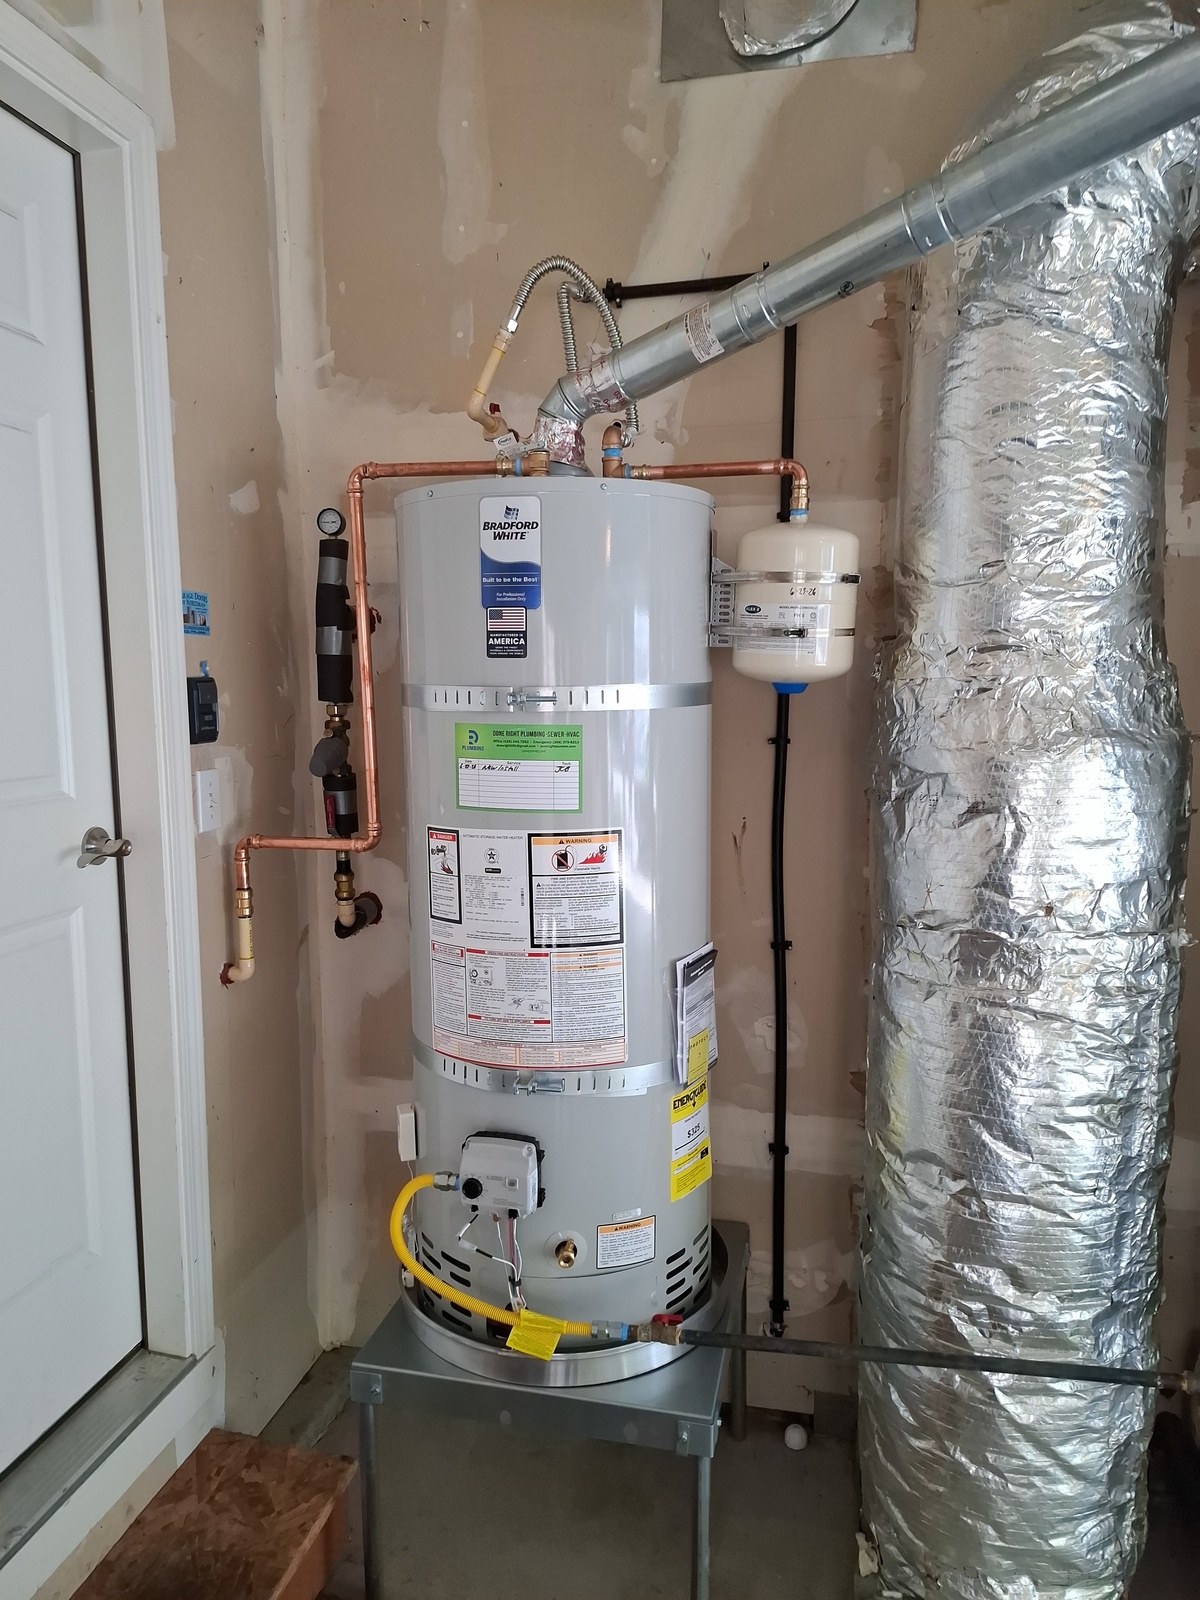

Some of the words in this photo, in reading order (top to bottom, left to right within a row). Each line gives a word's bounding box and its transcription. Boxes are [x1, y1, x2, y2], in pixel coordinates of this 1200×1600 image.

[483, 521, 539, 531] BRADFORD
[493, 531, 526, 541] WHITE
[488, 637, 525, 645] AMERICA
[687, 1123, 701, 1138] $325
[619, 1222, 641, 1230] WARNING
